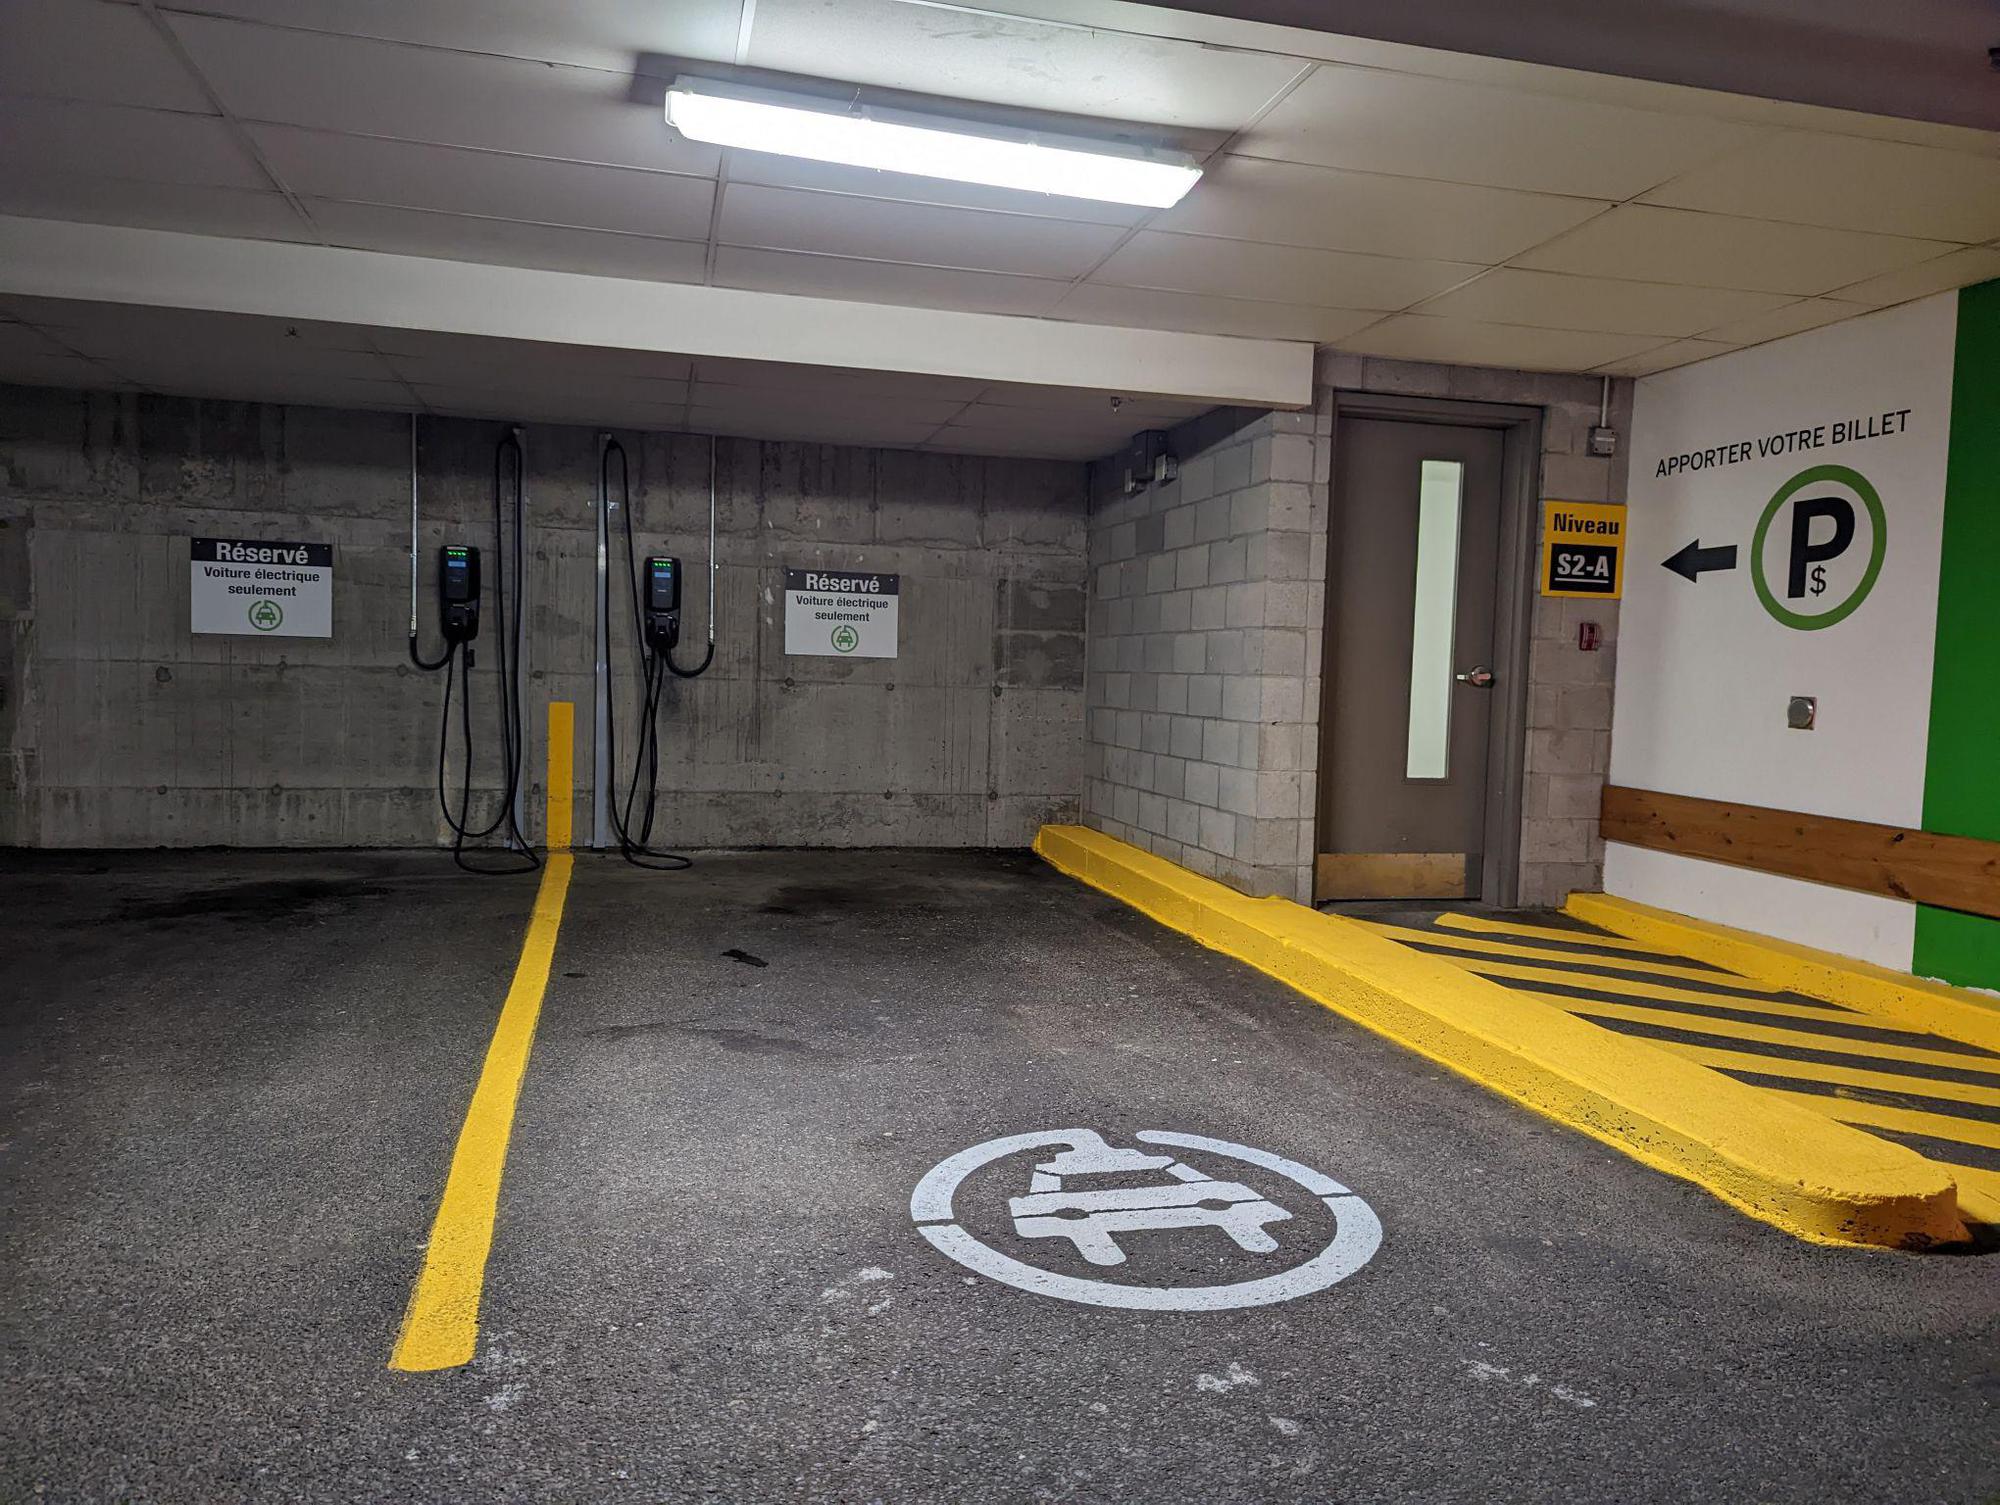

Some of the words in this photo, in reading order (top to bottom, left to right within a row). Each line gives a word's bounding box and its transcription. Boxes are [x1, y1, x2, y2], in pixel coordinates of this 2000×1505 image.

[1655, 441, 1752, 478] APPORTER
[1757, 426, 1826, 458] VOTRE
[1831, 409, 1912, 445] BILLET
[1553, 512, 1620, 535] Niveau
[215, 541, 310, 565] Réservé
[1787, 496, 1856, 599] P
[203, 565, 251, 579] Voiture
[254, 568, 321, 583] électrique
[1556, 552, 1610, 578] S2-A
[227, 584, 297, 597] seulement
[805, 572, 881, 593] Réservé
[795, 594, 834, 607] Voiture
[836, 596, 889, 610] électrique
[814, 611, 870, 622] seulement
